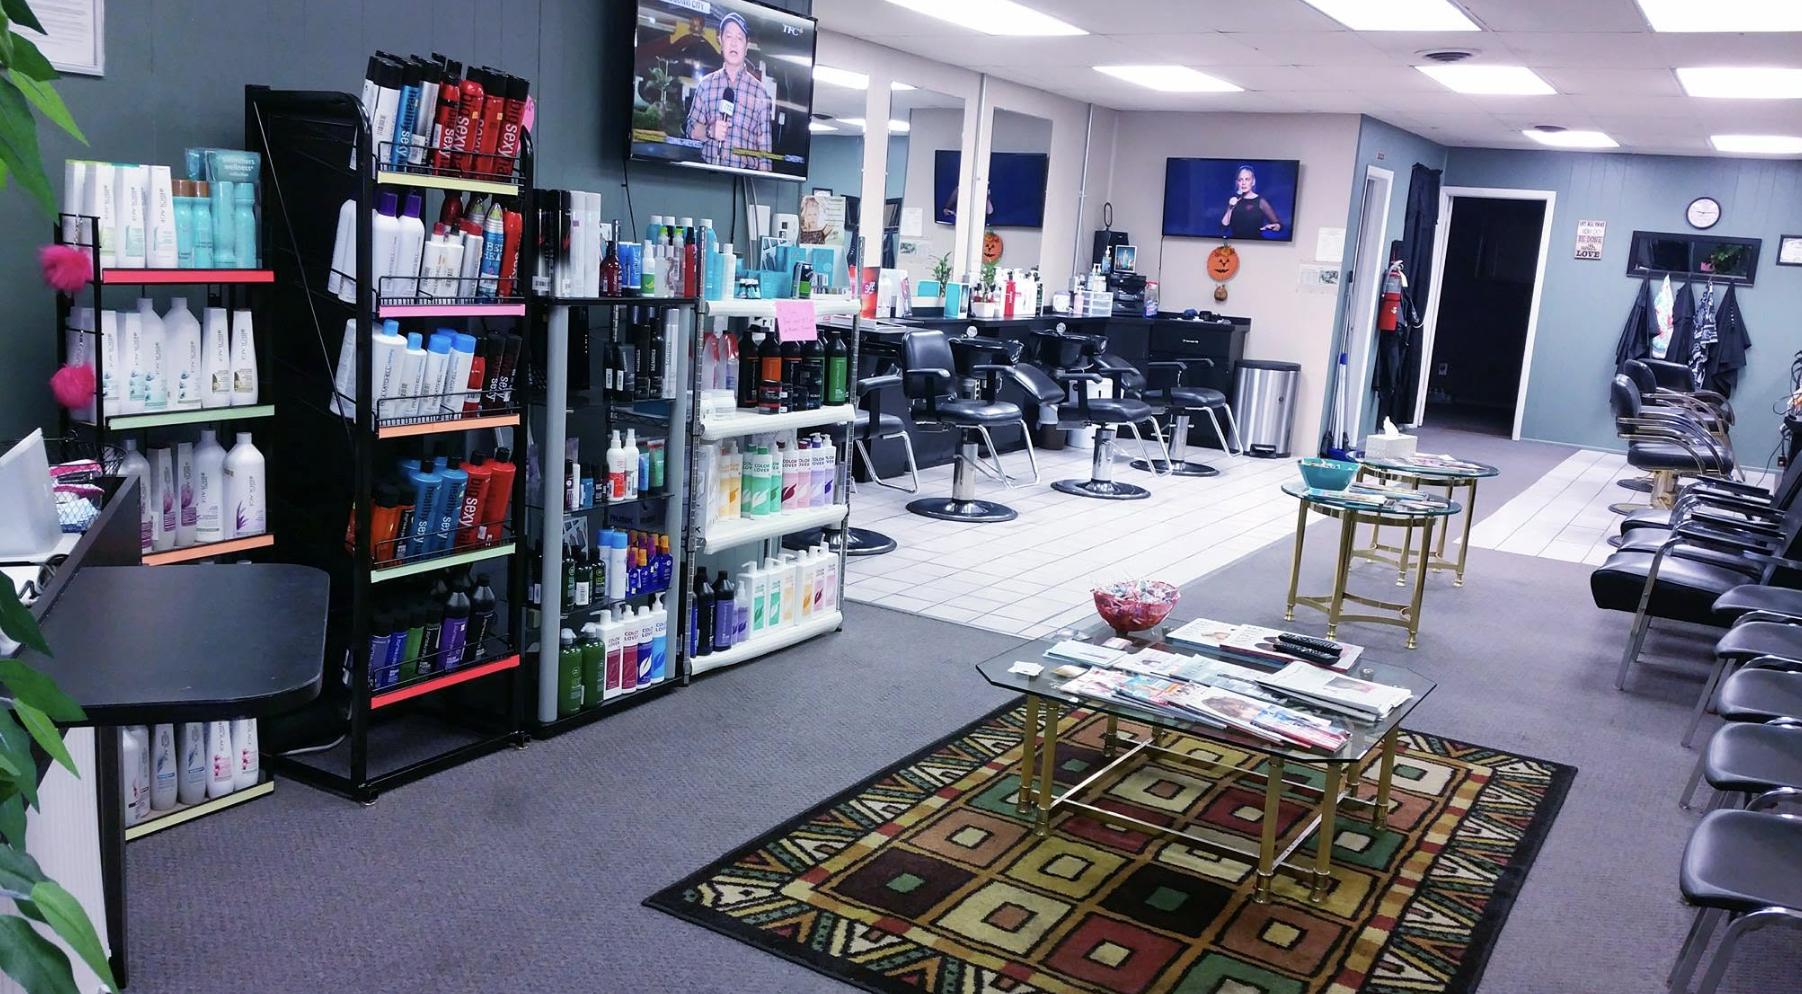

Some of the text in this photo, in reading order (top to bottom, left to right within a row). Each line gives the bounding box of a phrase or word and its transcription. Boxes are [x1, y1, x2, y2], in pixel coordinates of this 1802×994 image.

[497, 123, 518, 158] sexy
[1575, 250, 1601, 258] LOVE
[459, 497, 478, 527] sexy
